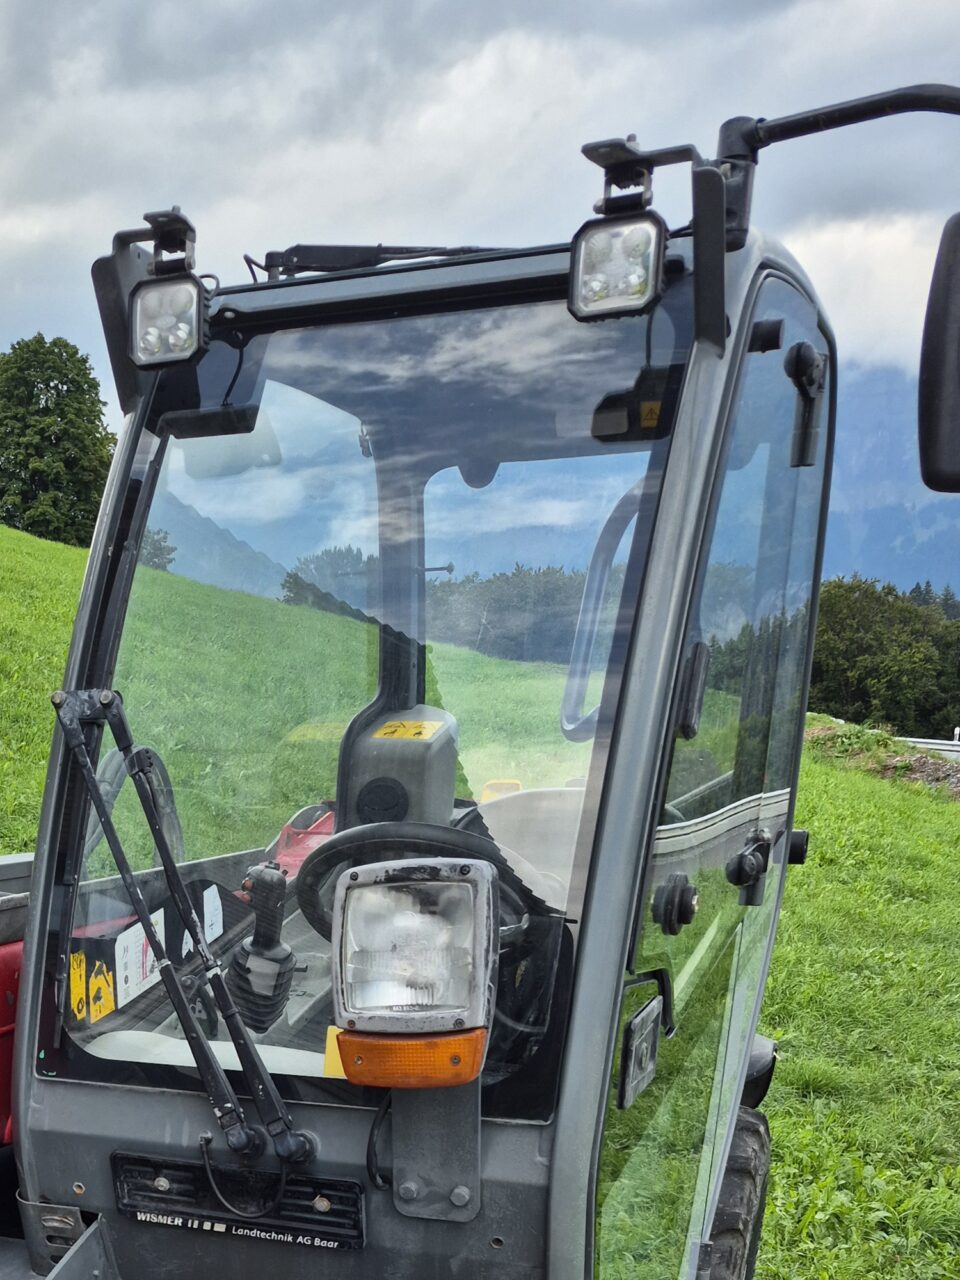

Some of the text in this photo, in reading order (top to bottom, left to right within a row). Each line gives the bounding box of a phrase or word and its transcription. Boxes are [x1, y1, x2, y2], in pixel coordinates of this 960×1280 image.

[136, 1211, 339, 1249] WISMER Landtechnik AG Baar
